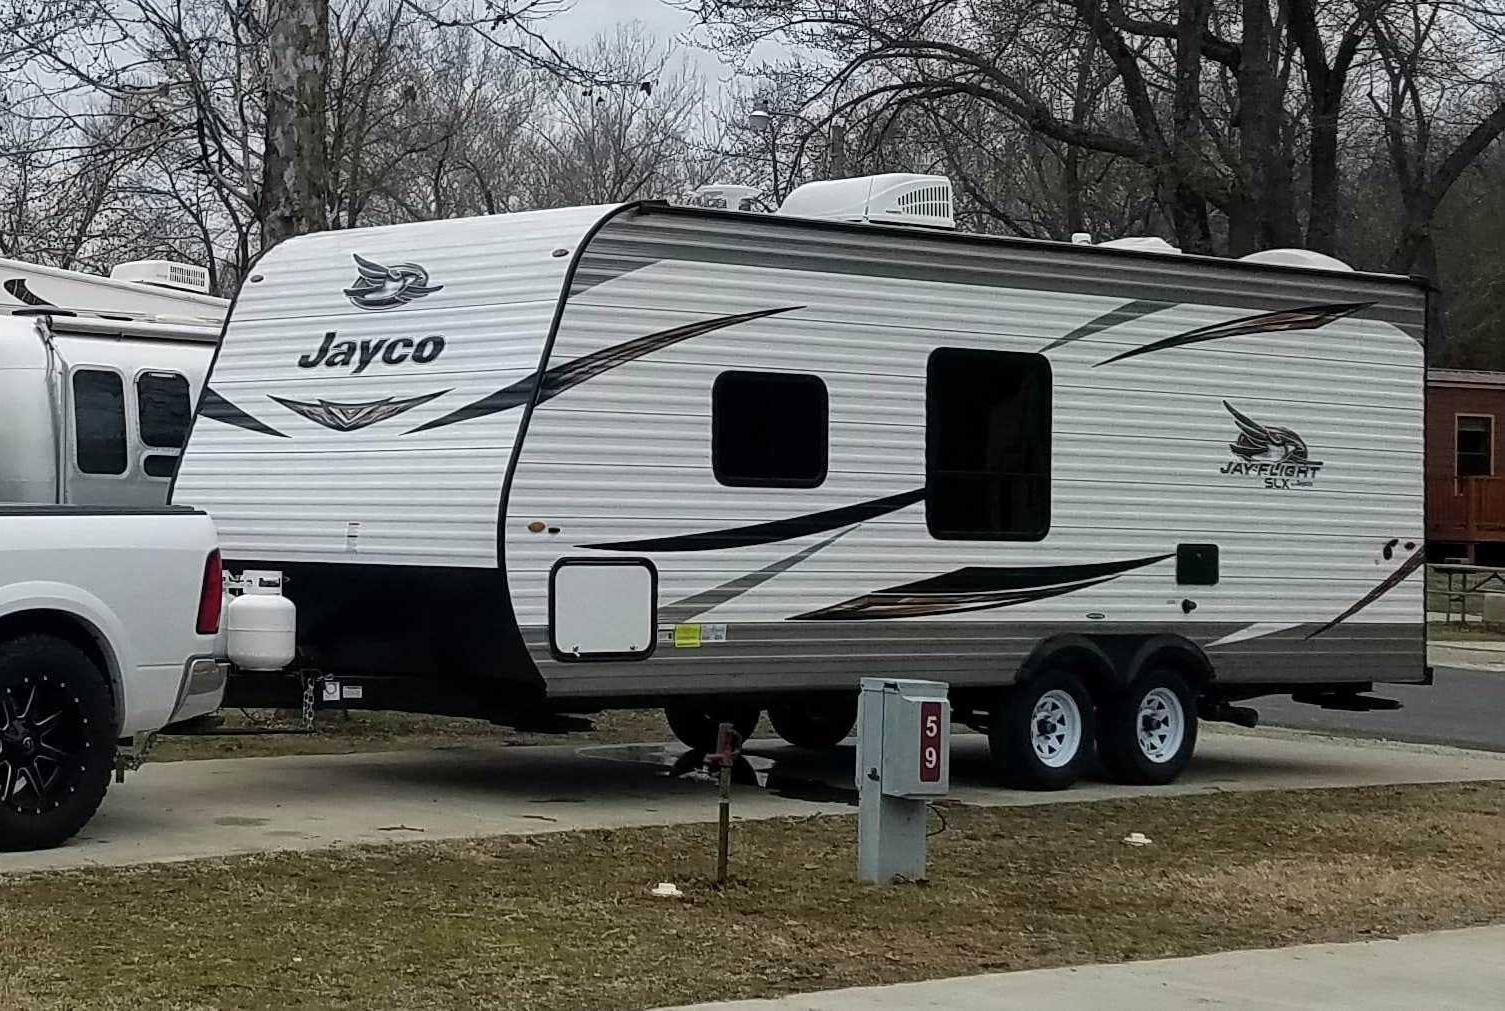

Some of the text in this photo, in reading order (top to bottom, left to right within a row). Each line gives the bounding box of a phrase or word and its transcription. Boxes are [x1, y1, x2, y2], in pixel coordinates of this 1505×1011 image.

[297, 331, 446, 374] Jayco
[1220, 461, 1321, 478] JAY FLIGHT
[1264, 478, 1290, 490] SLX
